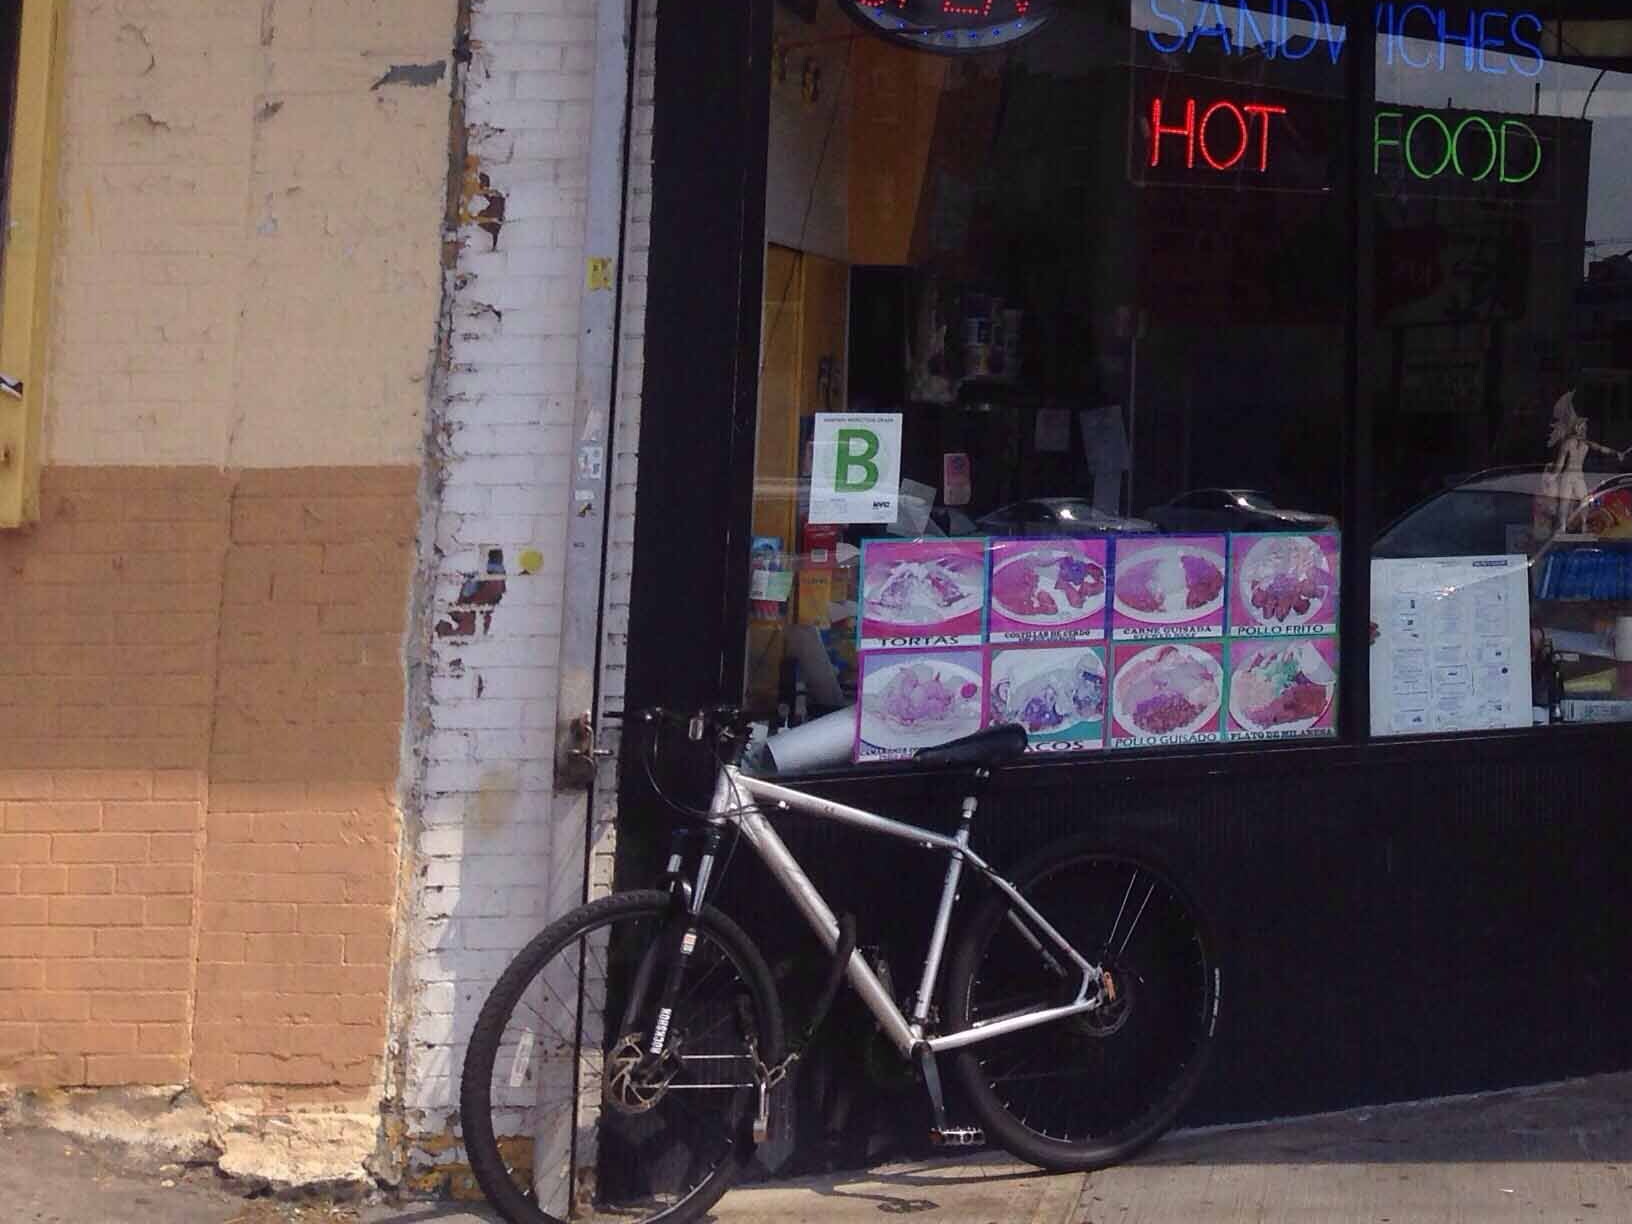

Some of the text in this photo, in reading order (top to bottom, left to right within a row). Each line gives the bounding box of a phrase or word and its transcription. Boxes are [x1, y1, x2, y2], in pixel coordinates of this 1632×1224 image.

[1149, 97, 1542, 184] HOT FOOD
[833, 428, 880, 493] B
[1164, 626, 1212, 634] GUISADA
[1237, 624, 1324, 636] POLLO FRITO
[878, 635, 960, 646] TORTAS
[1115, 733, 1217, 747] POLLO GUISADO
[1230, 730, 1264, 741] PLATO
[1025, 740, 1084, 752] ACOS
[649, 1007, 673, 1055] ROCKSHOX
